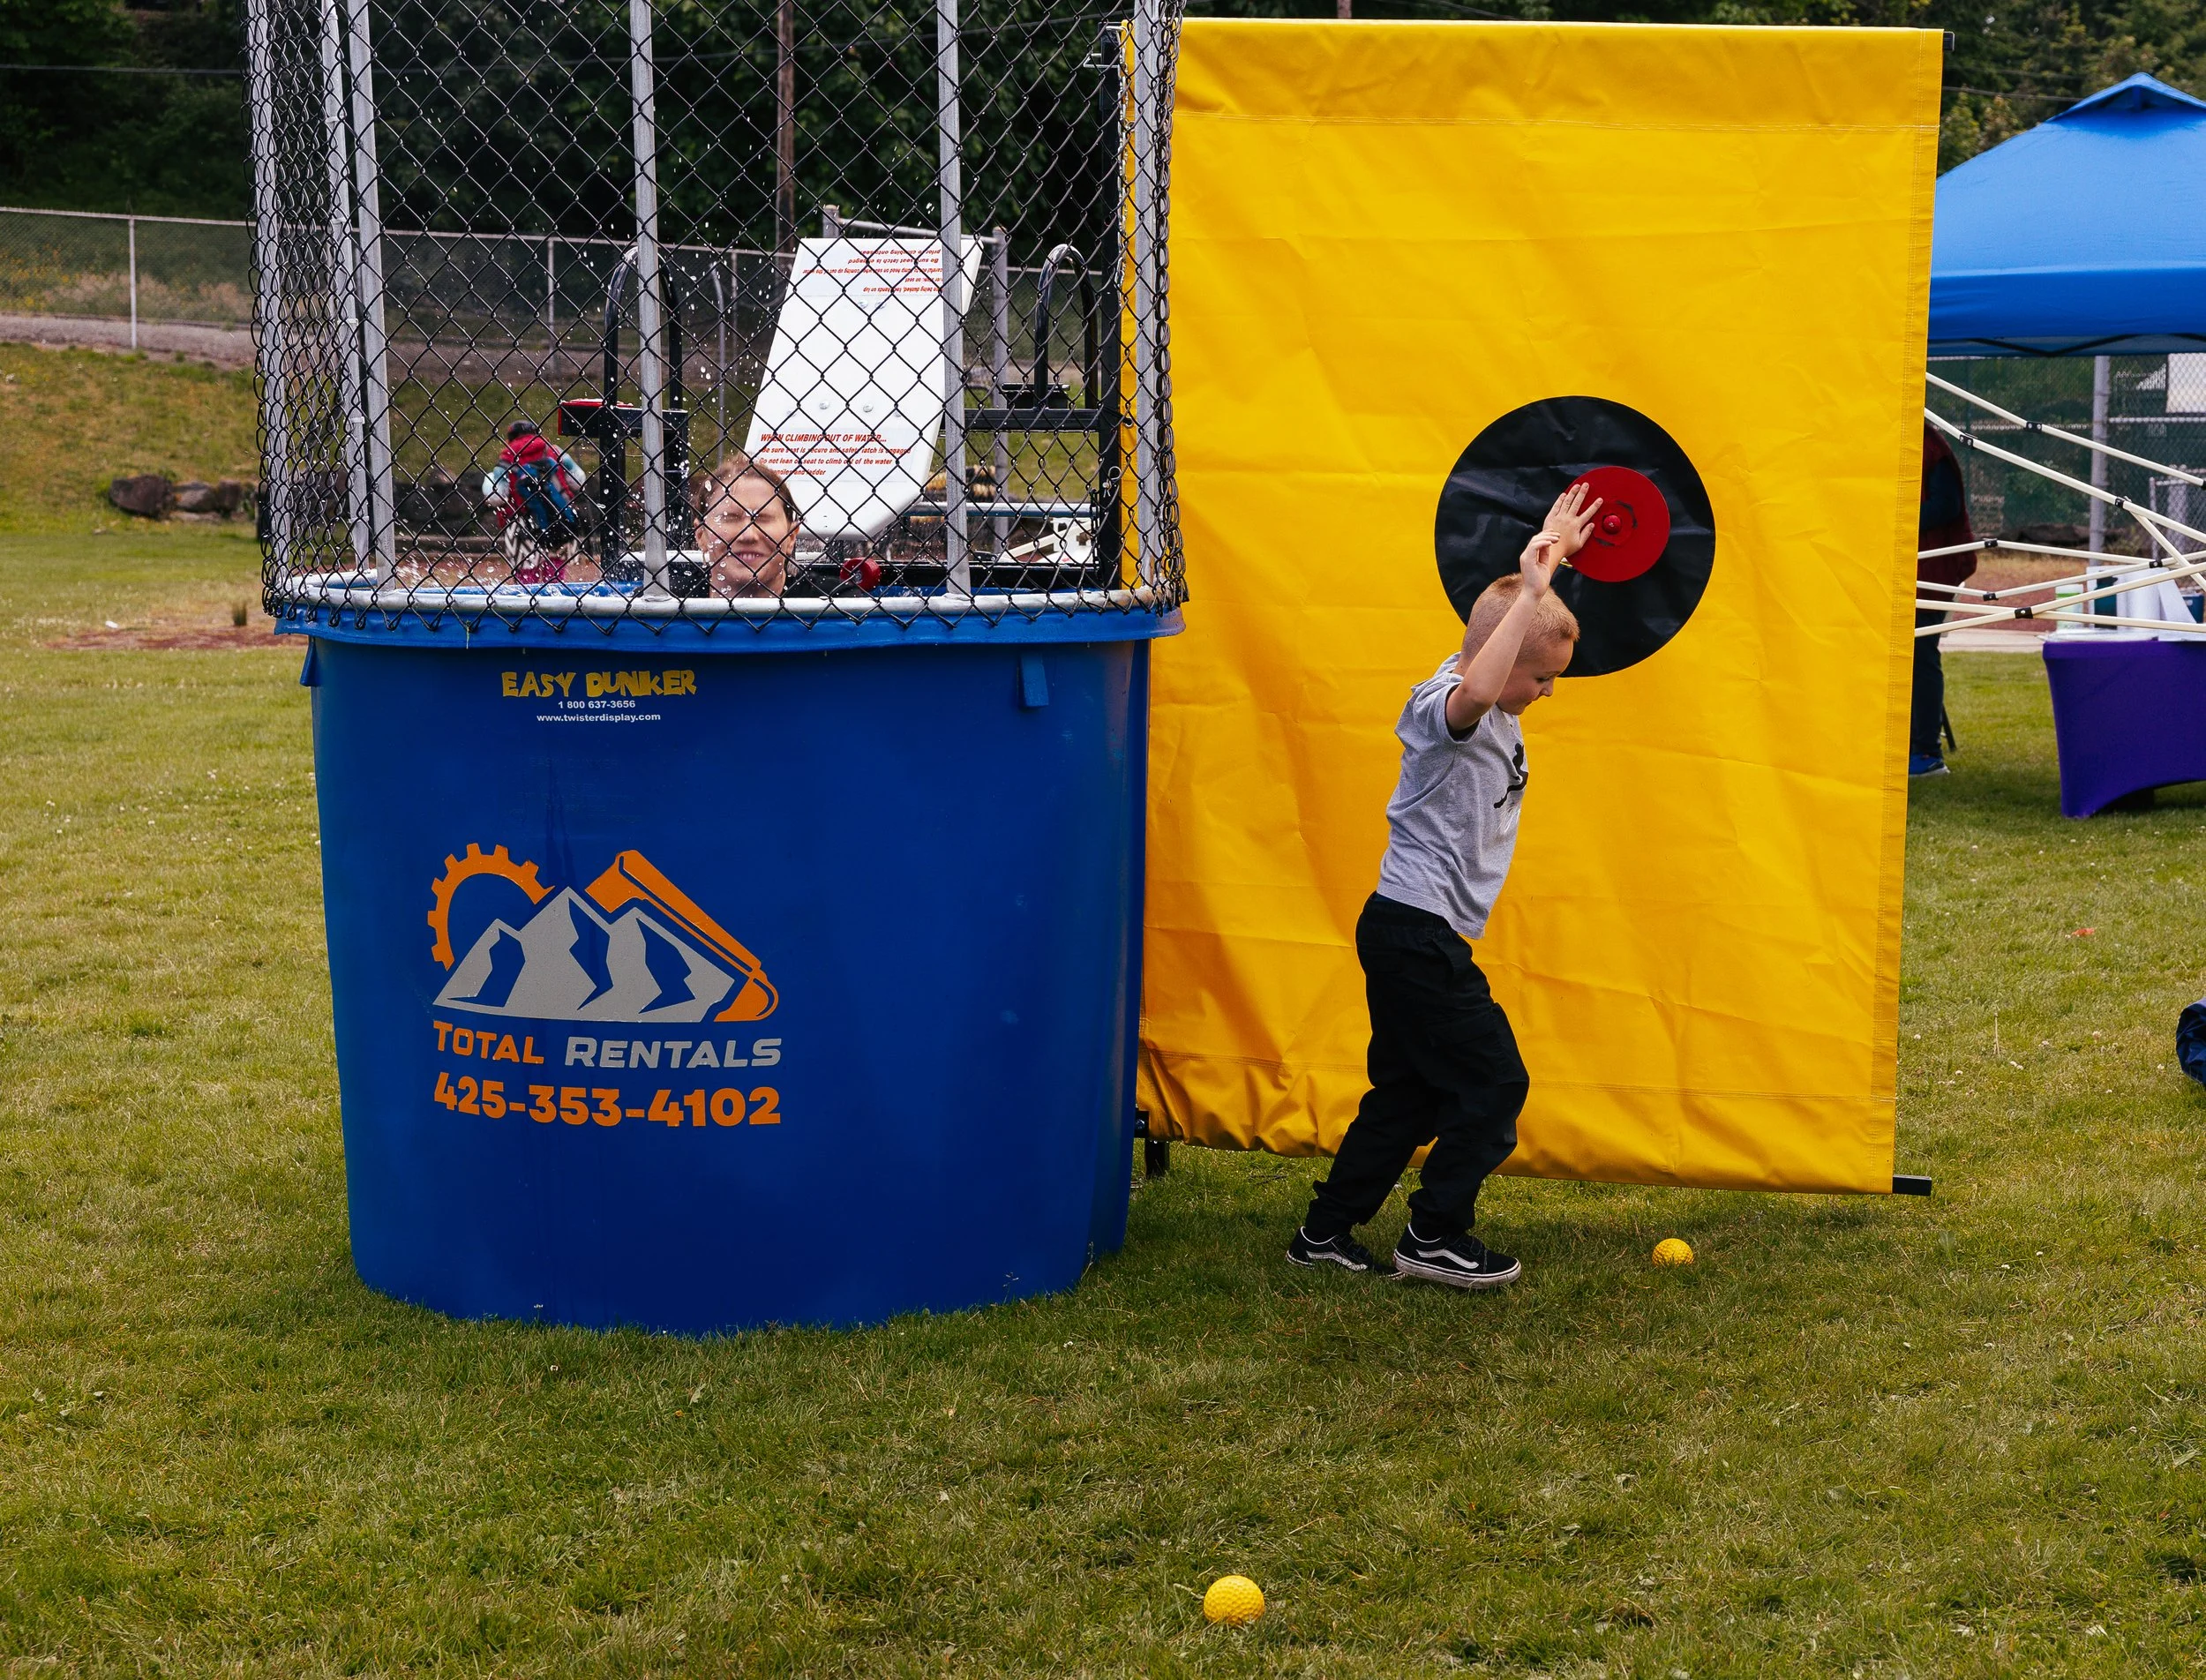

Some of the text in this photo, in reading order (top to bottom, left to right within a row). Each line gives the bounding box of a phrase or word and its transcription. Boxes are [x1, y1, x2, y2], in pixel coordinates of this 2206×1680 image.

[502, 670, 697, 698] EASY DUNKER
[536, 713, 661, 723] www.twisterdisplay.com
[588, 700, 636, 709] 637-3656
[432, 1020, 782, 1068] TOTAL RENTALS
[433, 1071, 781, 1127] 425-353-4102
